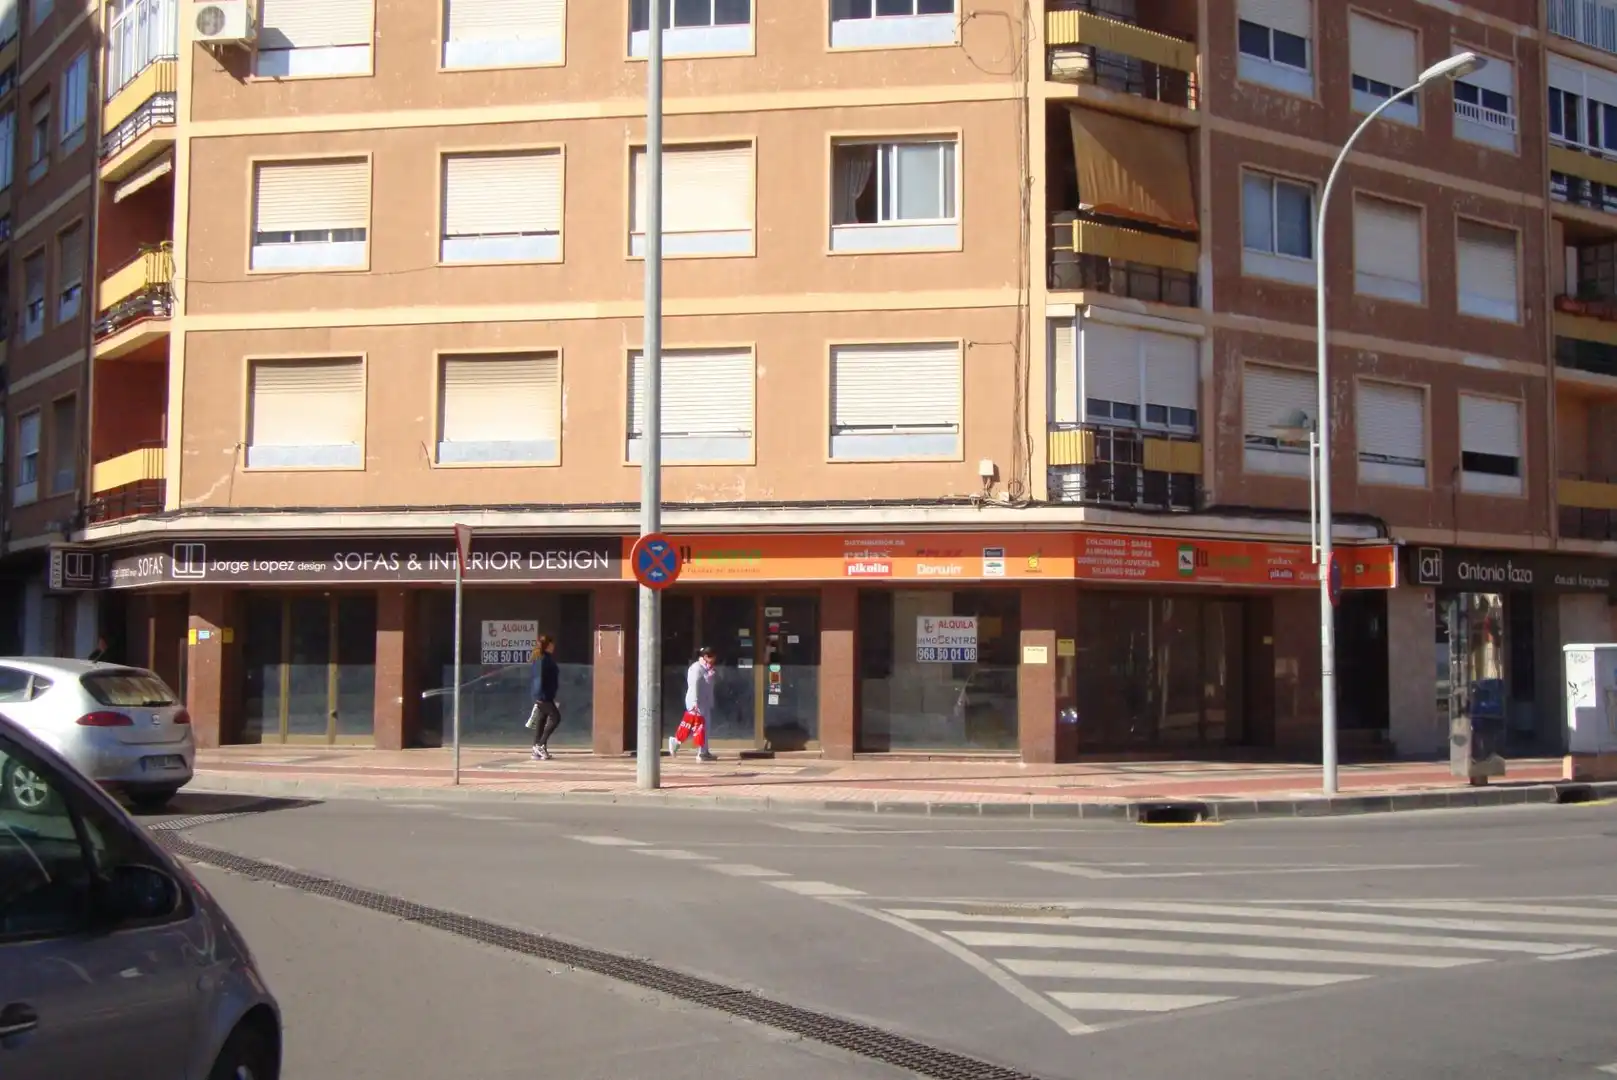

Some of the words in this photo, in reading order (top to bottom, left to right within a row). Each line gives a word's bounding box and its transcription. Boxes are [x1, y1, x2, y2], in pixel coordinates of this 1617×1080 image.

[333, 552, 400, 571] SOFAS
[407, 553, 423, 571] &
[529, 549, 609, 569] DESIGN
[138, 556, 164, 577] SOFAS
[210, 559, 249, 574] Jorge
[253, 559, 294, 573] Lopez
[297, 561, 326, 572] design
[847, 563, 889, 576] pikolin
[501, 623, 535, 632] ALQUILA
[938, 620, 974, 629] ALQUILA
[483, 650, 499, 662] 968
[500, 650, 511, 662] 50
[513, 650, 523, 662] 01
[918, 648, 935, 660] 968
[938, 648, 948, 660] 50
[951, 648, 961, 660] 01
[964, 648, 975, 660] 08
